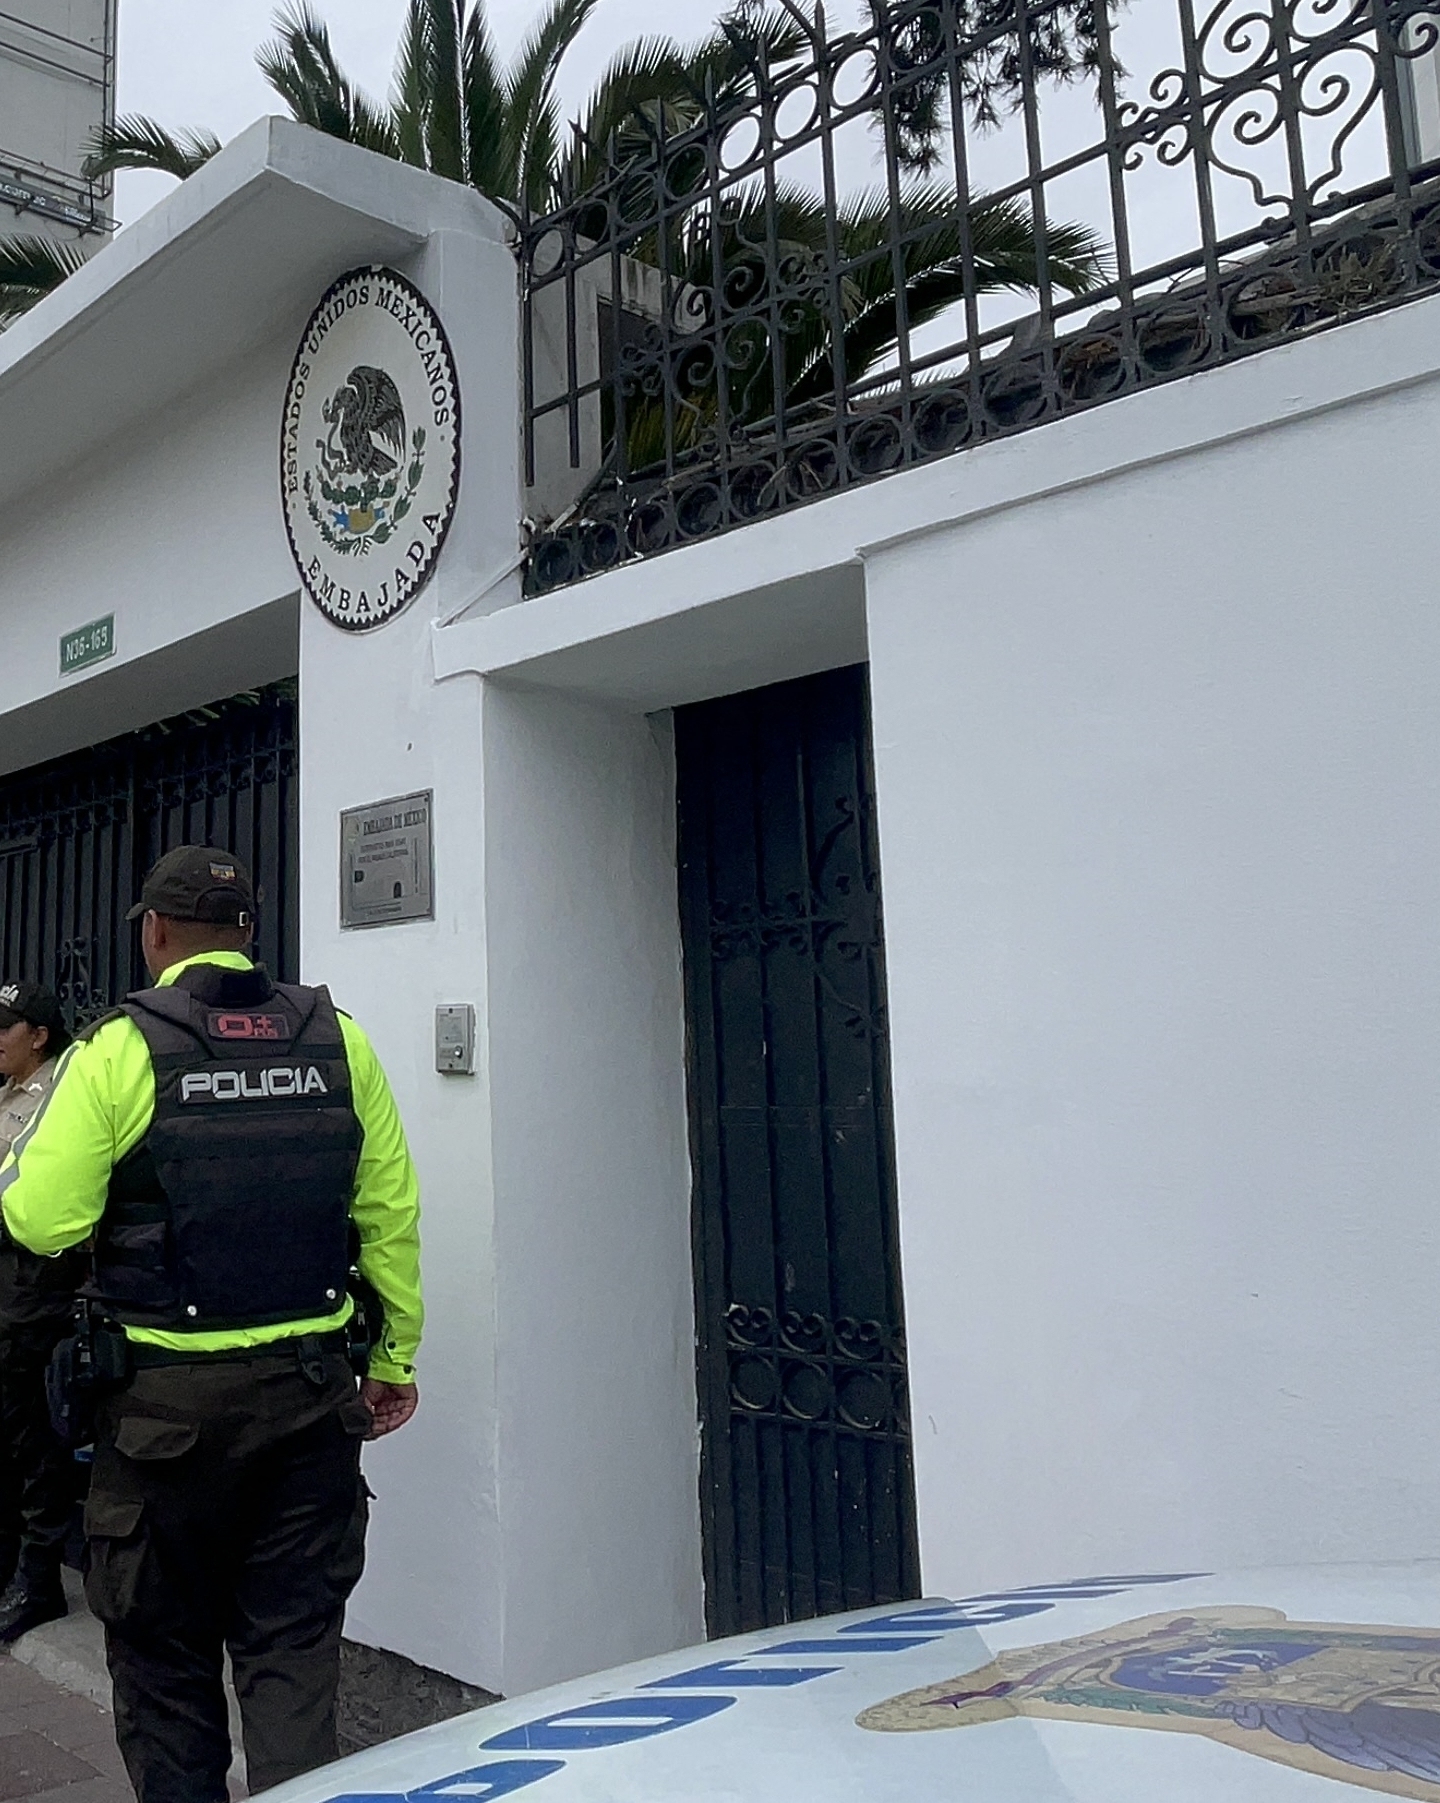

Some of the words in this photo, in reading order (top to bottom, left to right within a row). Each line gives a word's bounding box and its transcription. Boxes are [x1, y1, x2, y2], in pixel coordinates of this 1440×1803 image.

[286, 362, 311, 493] ESTADOS
[306, 284, 371, 355] UNIDOS
[373, 285, 451, 428] MEXICANOS
[308, 511, 442, 614] EMBAJADA
[66, 625, 108, 662] N36-165
[181, 1066, 328, 1101] POLICIA
